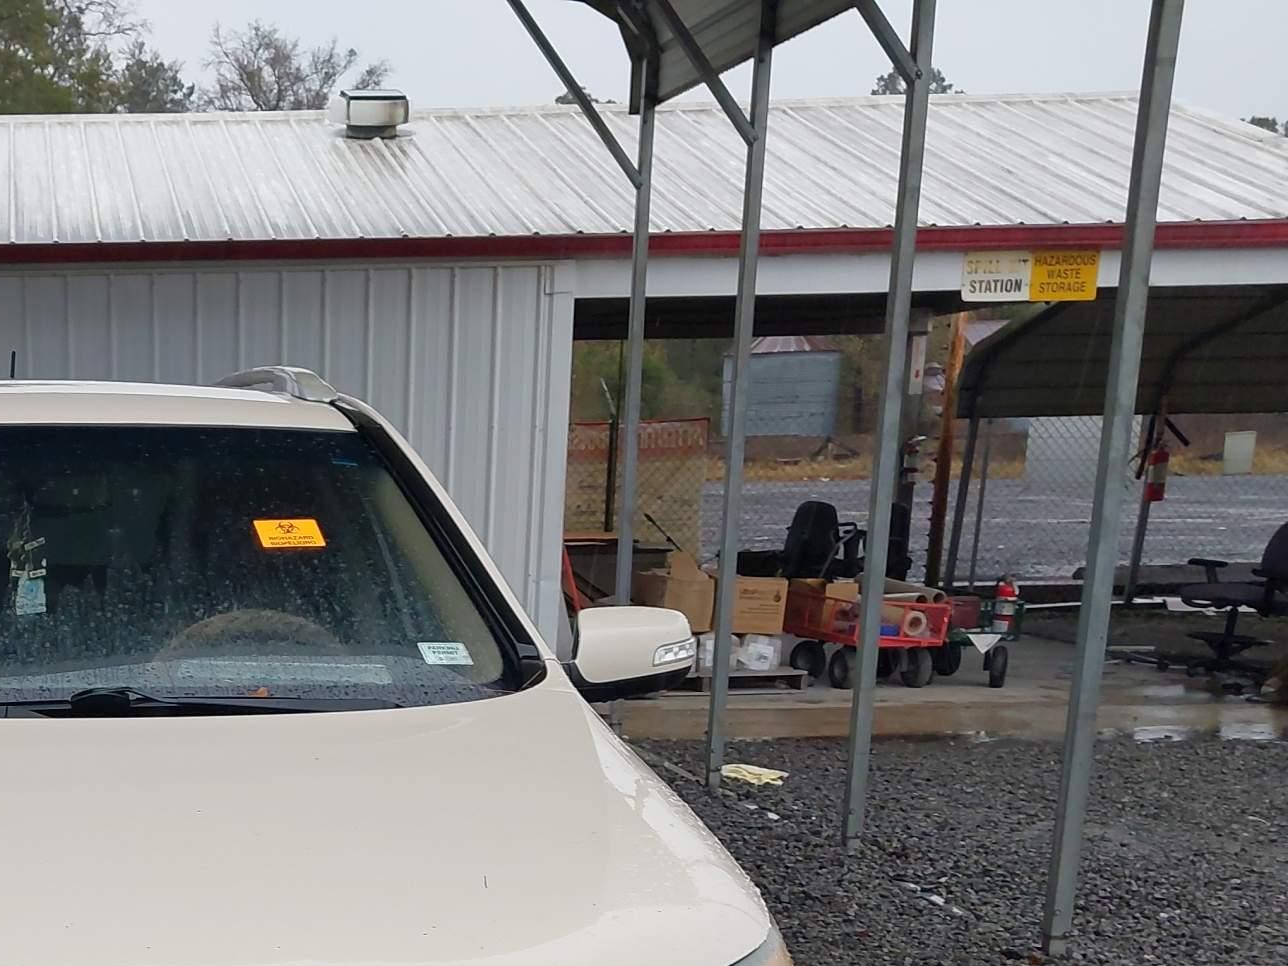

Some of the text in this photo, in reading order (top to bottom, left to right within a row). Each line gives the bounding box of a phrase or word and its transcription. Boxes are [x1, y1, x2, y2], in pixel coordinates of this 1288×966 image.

[1034, 254, 1097, 267] HAZARDOUS
[1047, 268, 1081, 279] WASTE
[968, 278, 1024, 294] STATION
[1039, 281, 1087, 294] STORAGE
